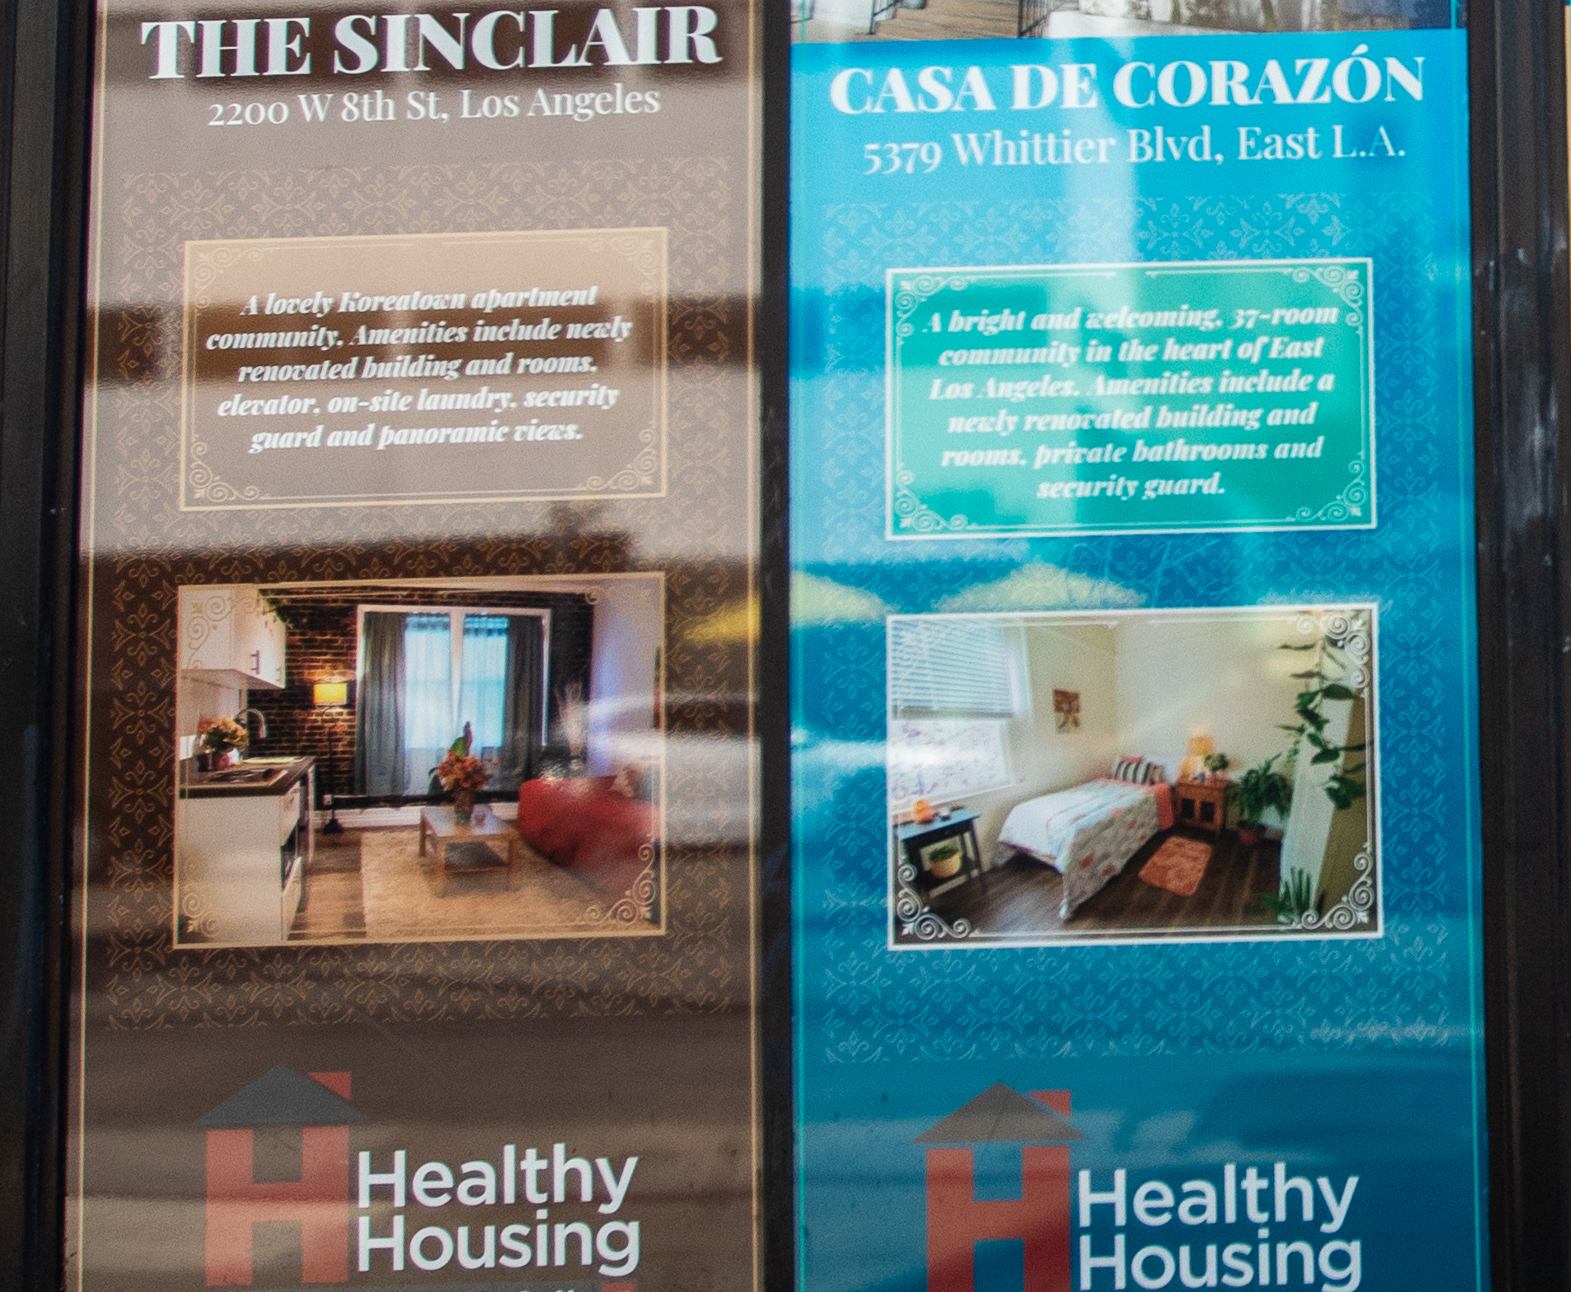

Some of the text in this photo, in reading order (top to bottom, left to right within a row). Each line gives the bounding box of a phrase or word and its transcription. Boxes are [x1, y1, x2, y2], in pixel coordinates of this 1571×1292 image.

[140, 6, 722, 79] THE SINCLAIR
[207, 82, 661, 127] 2200 W 8th St, Los Angeles
[829, 44, 1424, 115] CASA DE CORAZÓN
[864, 124, 1406, 175] 5379 Whittier Blvd, East L.A.
[239, 285, 599, 319] A lovely Koreatown apartment
[938, 335, 1326, 368] community in the heart of East
[356, 1142, 639, 1215] Healthy
[1078, 1160, 1359, 1234] Healthy
[356, 1208, 640, 1278] Housing
